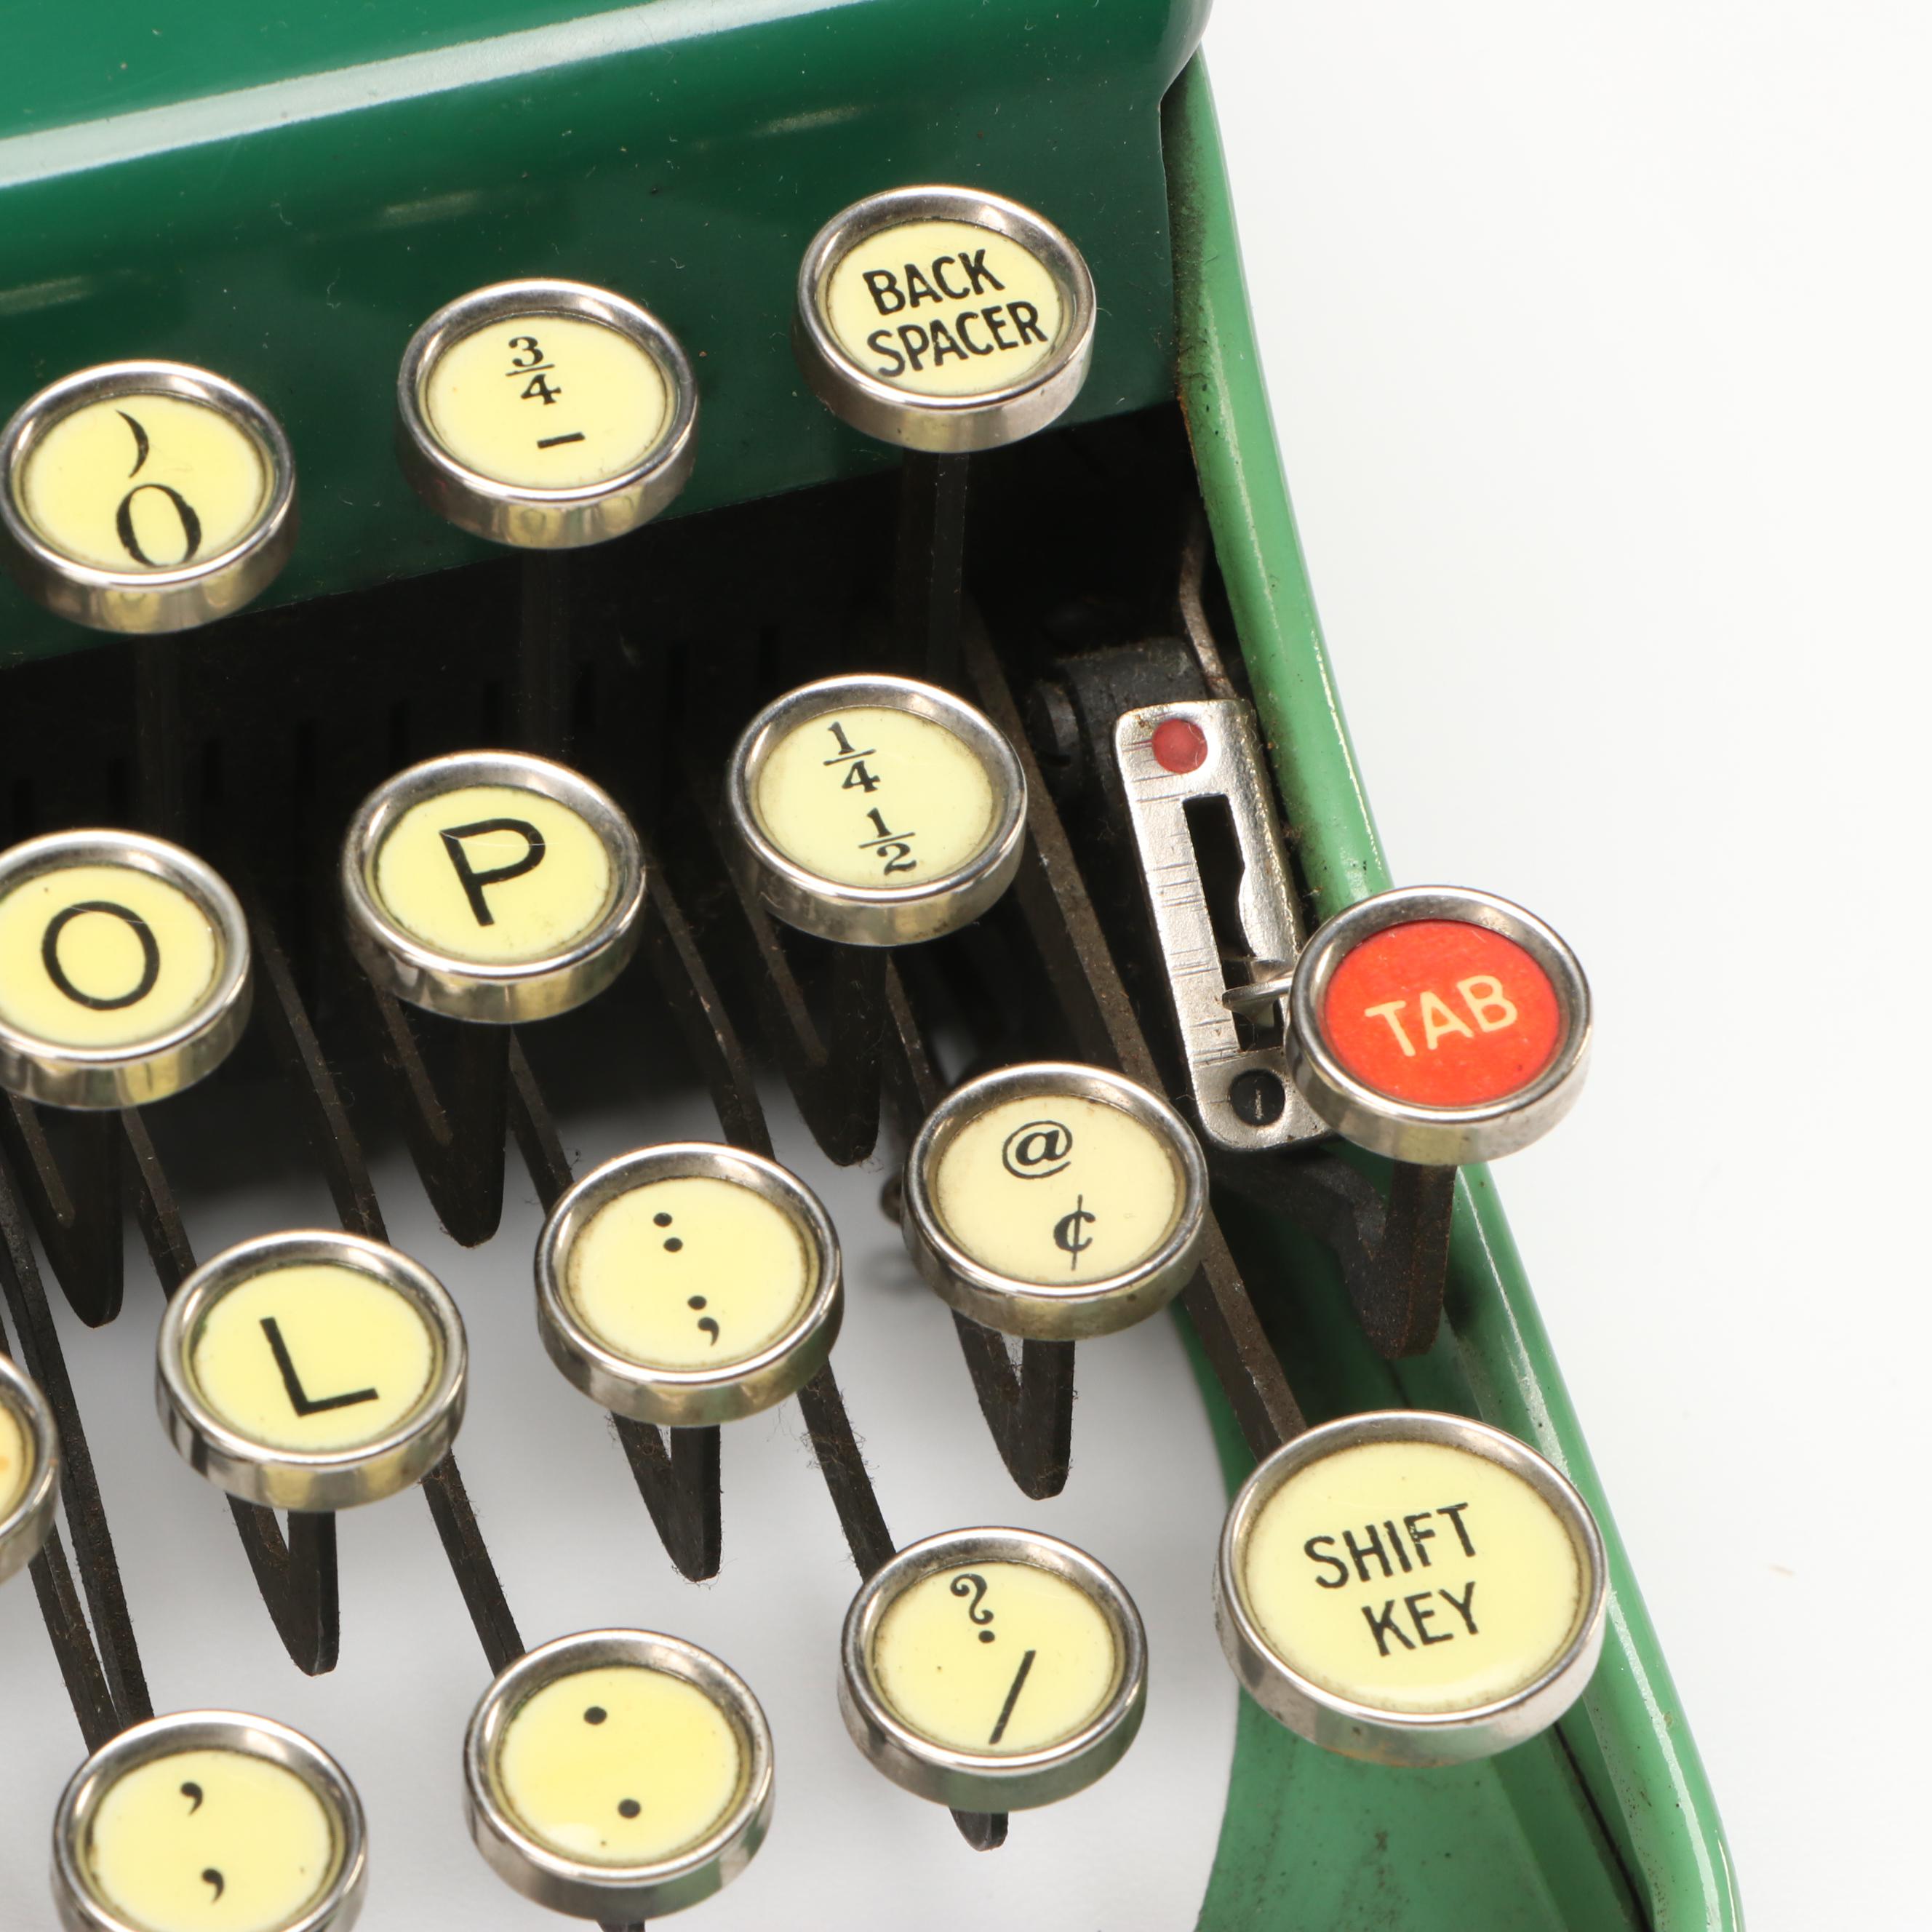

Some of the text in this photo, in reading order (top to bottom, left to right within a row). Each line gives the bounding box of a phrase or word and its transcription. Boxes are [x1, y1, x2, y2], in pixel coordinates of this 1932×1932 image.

[861, 249, 1005, 316] BACK
[866, 300, 1048, 378] SPACER
[439, 817, 547, 927] P
[41, 901, 161, 1011] O
[1364, 973, 1520, 1058] TAB
[1001, 1119, 1074, 1180] @
[1053, 1194, 1097, 1272] ¢
[260, 1317, 379, 1418] L
[1304, 1501, 1476, 1589] SHIFT
[950, 1573, 995, 1644] ?
[1361, 1581, 1480, 1657] KEY
